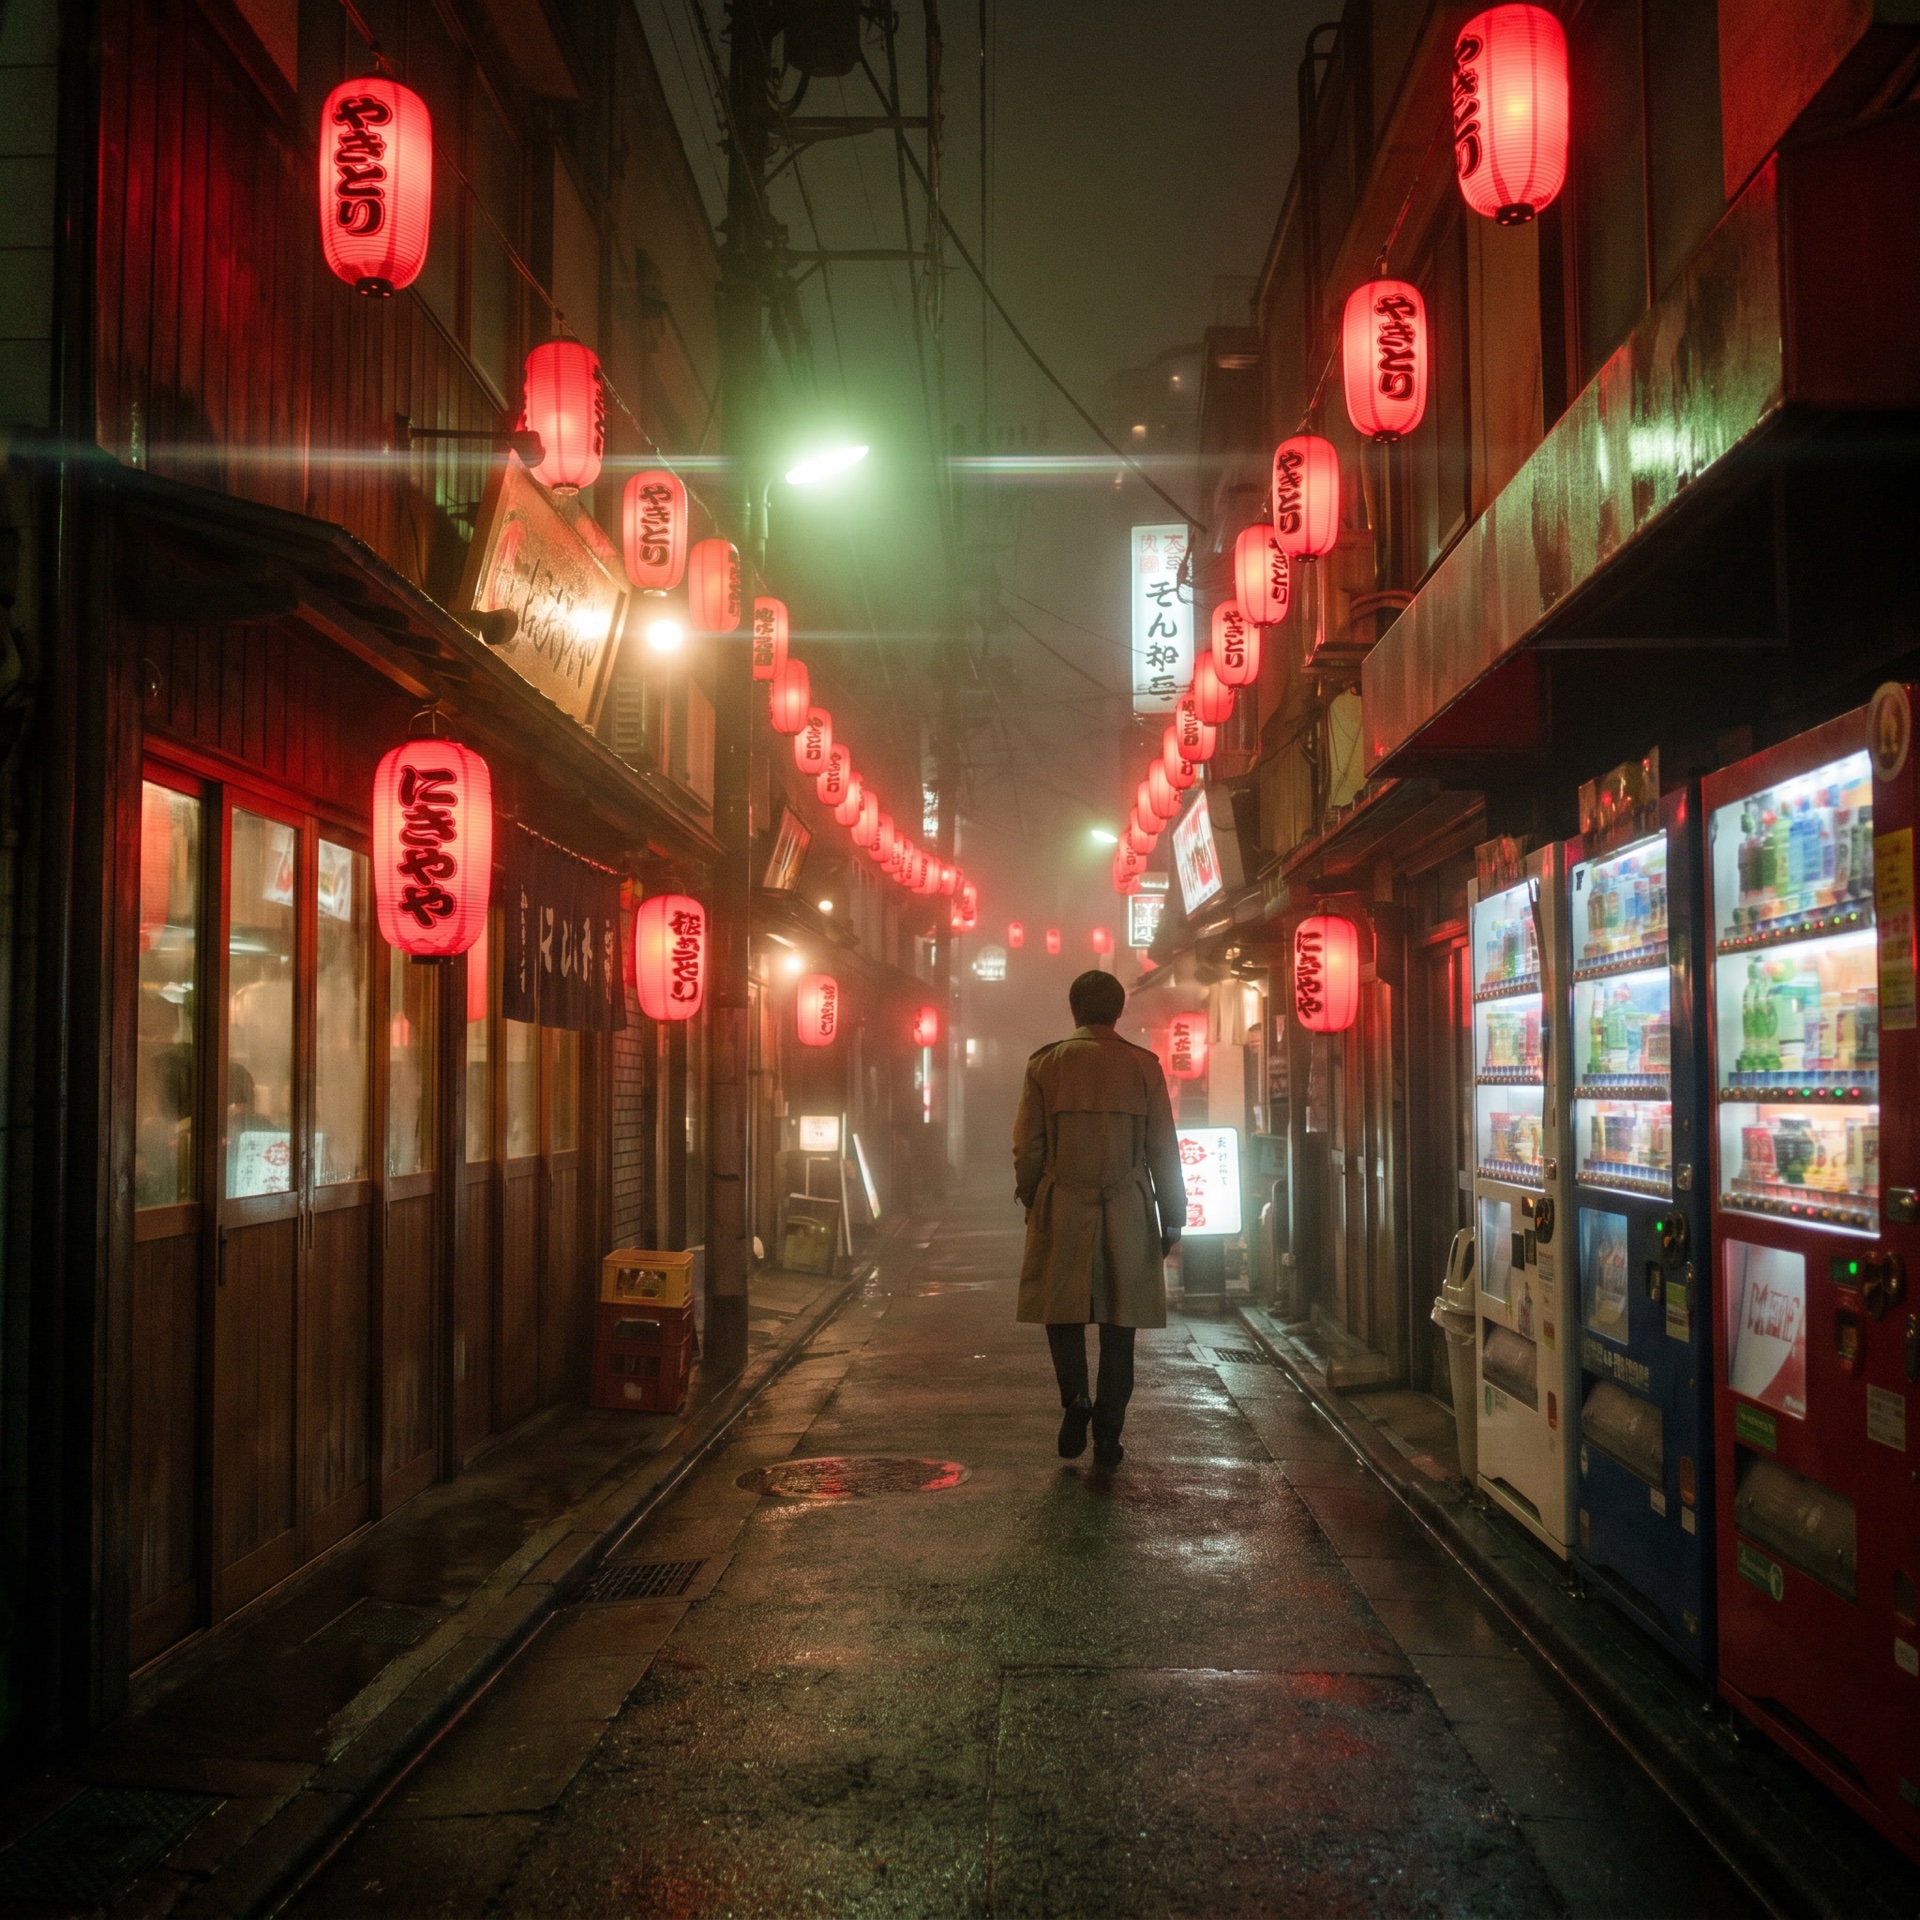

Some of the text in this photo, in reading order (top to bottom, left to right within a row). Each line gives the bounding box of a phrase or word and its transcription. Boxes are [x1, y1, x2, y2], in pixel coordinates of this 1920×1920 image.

[333, 95, 392, 236] やきとり
[1375, 294, 1417, 401] やきとり
[639, 483, 672, 567] やきとり
[1277, 450, 1304, 534] やきとり
[1223, 610, 1244, 668] やきとり
[398, 765, 458, 928] にきやや
[1296, 931, 1323, 1020] にきやや
